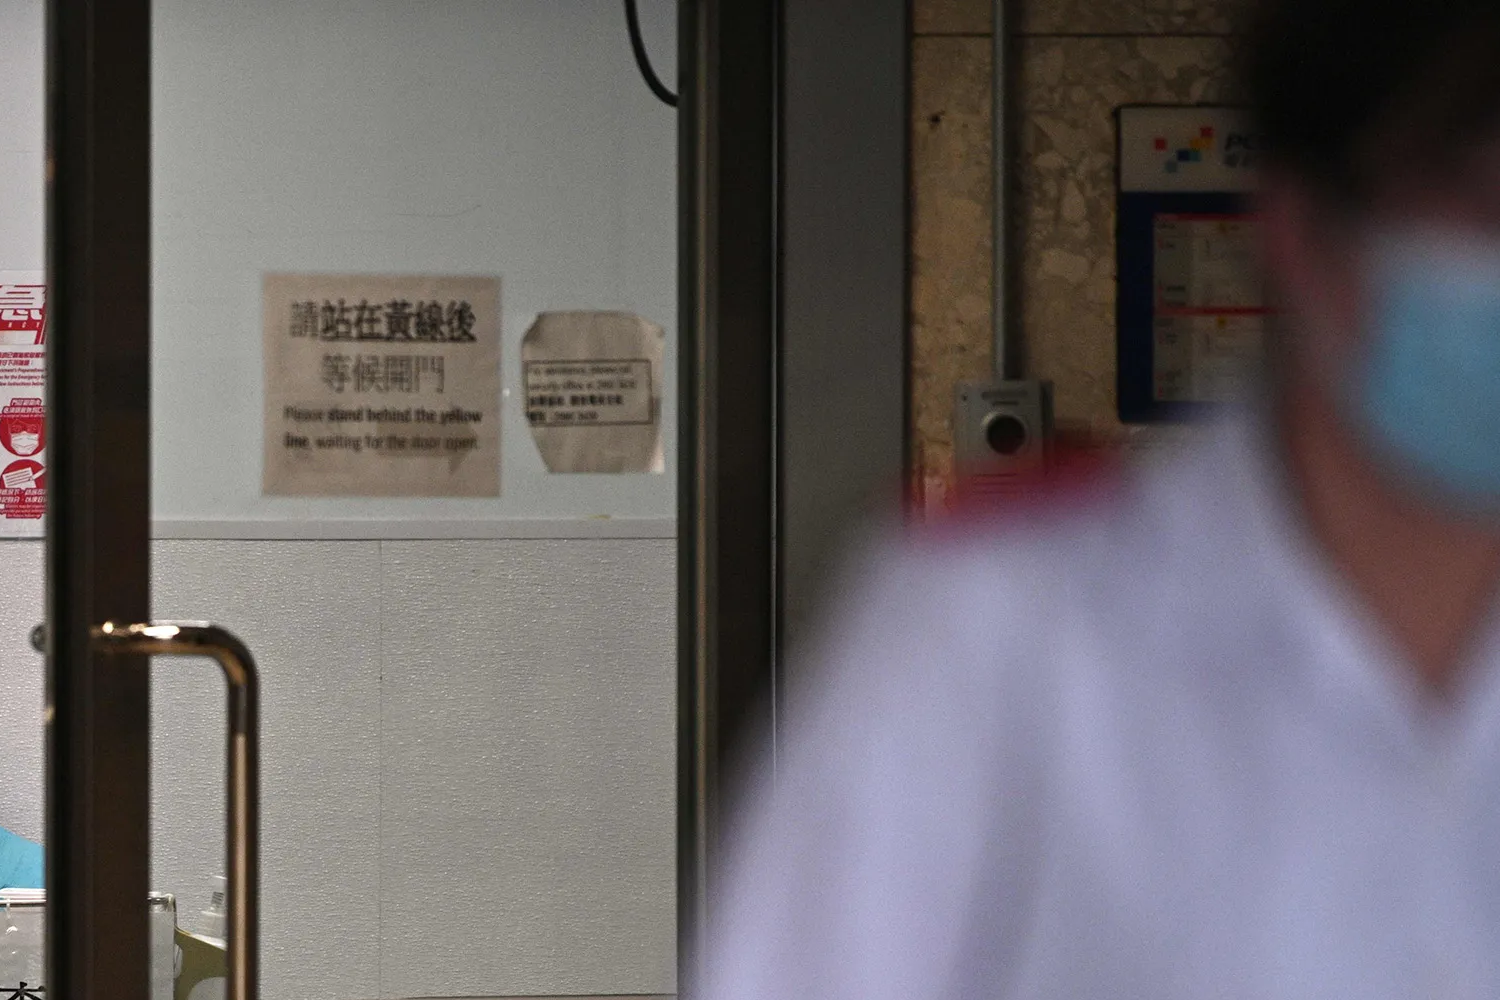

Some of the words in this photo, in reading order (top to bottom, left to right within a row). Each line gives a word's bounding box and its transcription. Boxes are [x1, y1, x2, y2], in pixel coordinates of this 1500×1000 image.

[289, 298, 477, 341] 請站在黃線後
[321, 354, 445, 394] 等候開門
[283, 405, 323, 423] Please
[327, 406, 363, 423] stand
[366, 406, 412, 423] behind
[415, 406, 437, 422] the
[440, 405, 482, 426] yellow
